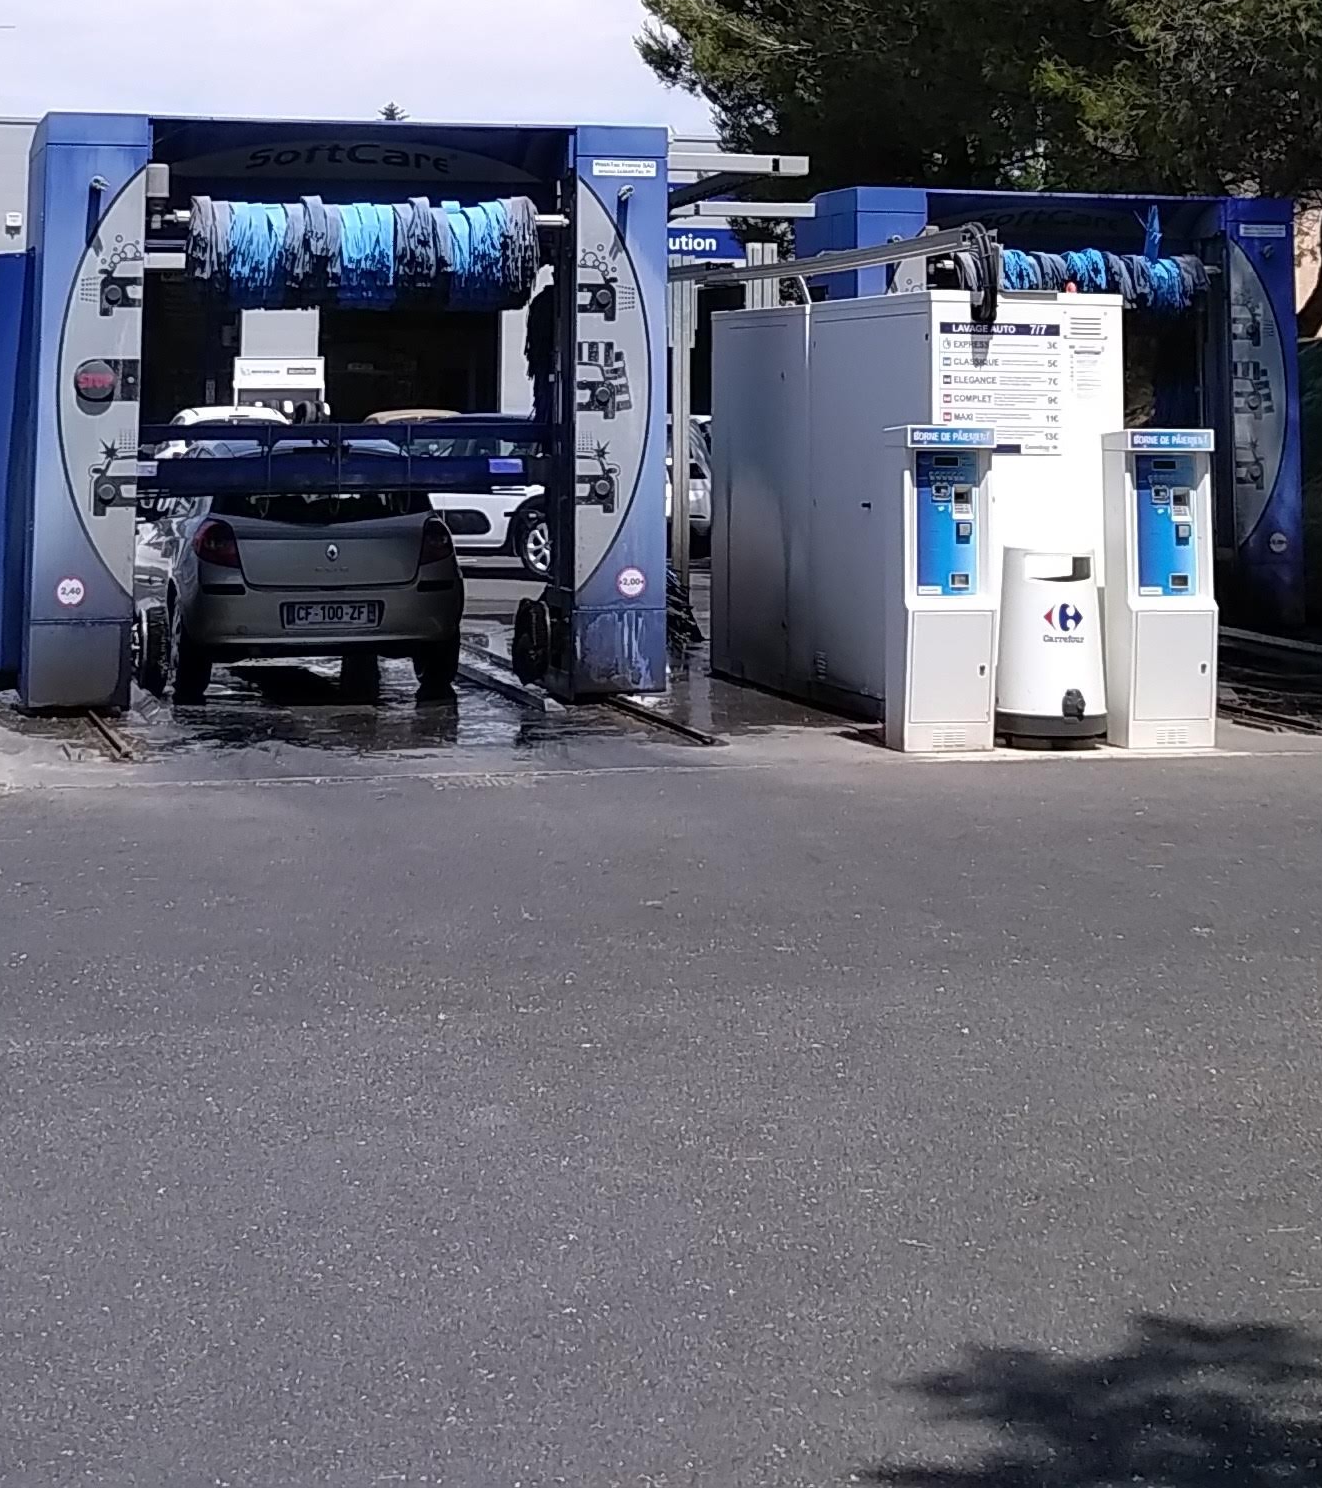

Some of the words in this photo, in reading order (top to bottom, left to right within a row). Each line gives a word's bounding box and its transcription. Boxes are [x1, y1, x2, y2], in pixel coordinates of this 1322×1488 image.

[245, 143, 451, 174] SoftCare
[669, 233, 717, 251] ution
[952, 324, 988, 333] LAVAGE
[991, 325, 1016, 334] AUTO
[1029, 324, 1047, 335] 7/7
[953, 376, 997, 385] ELEGANCE
[953, 395, 992, 403] COMPLET
[953, 413, 973, 421] MAXI
[941, 431, 951, 441] DE
[296, 605, 366, 621] CF-100-ZF
[1043, 634, 1085, 644] Carrefour
